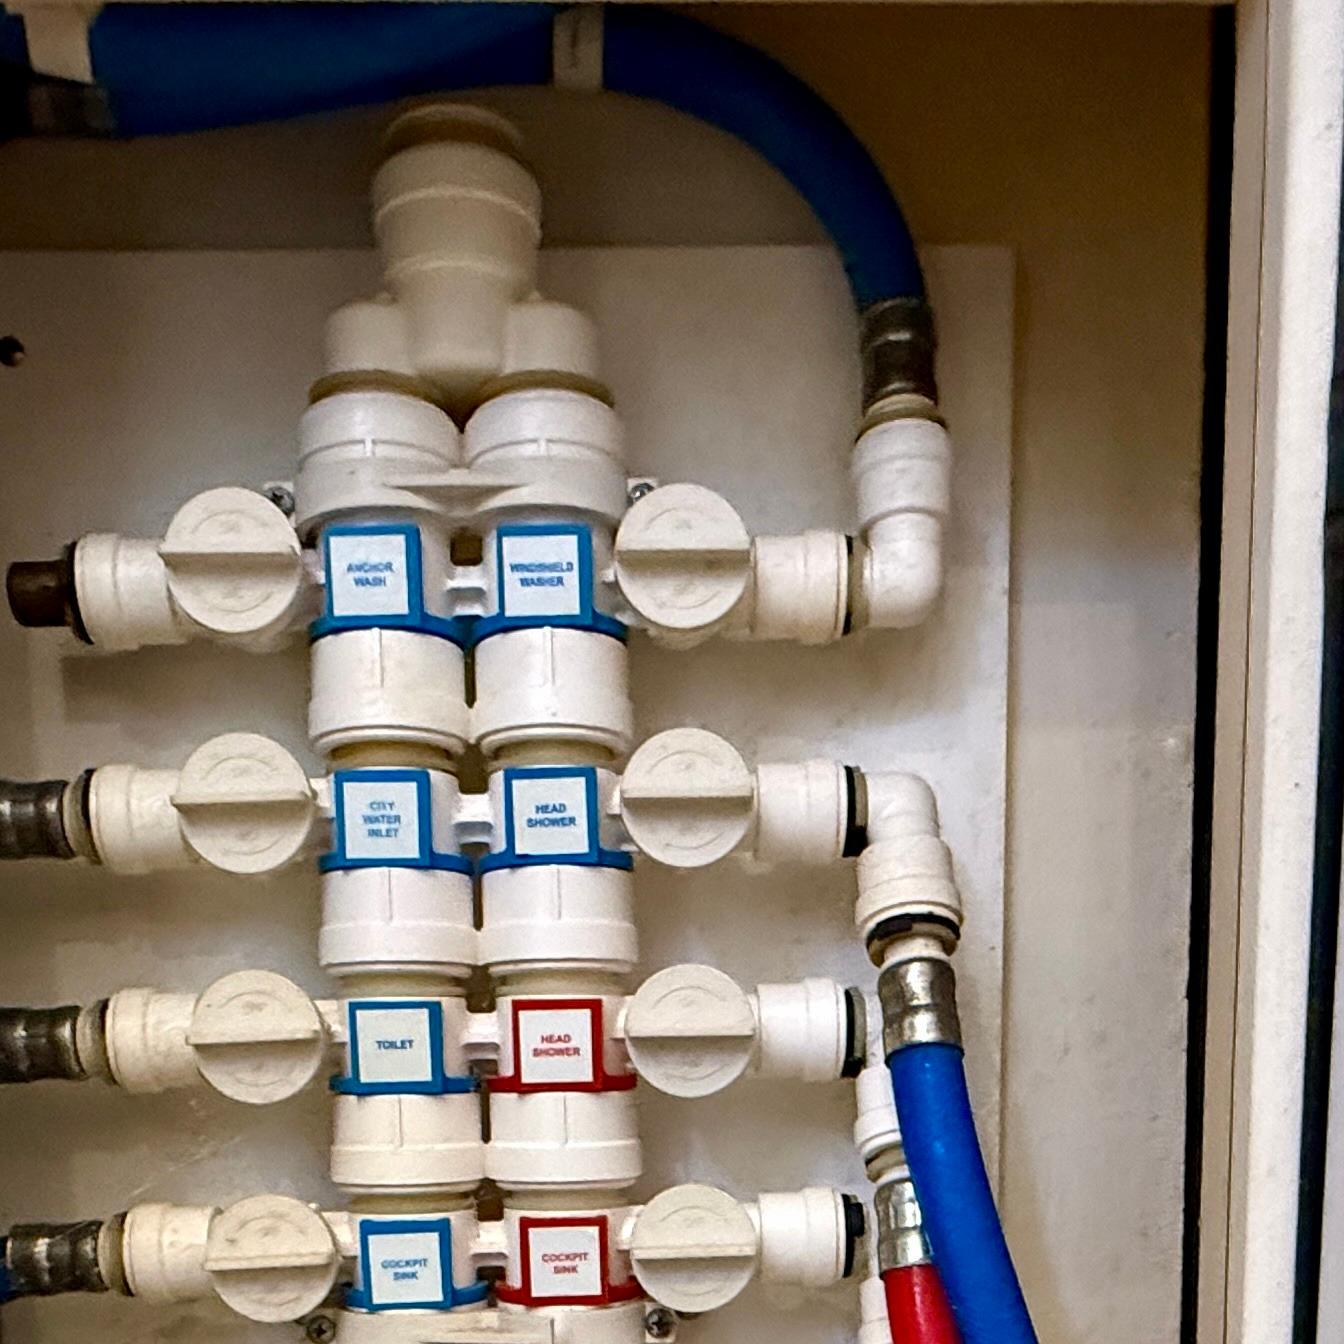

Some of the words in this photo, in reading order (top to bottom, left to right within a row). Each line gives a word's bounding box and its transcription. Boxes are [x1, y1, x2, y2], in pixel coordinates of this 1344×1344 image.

[354, 577, 386, 587] WASH
[519, 577, 564, 587] WASHER
[535, 804, 566, 813] HEAD
[362, 814, 401, 825] WATER
[527, 817, 576, 827] SHOWER
[367, 827, 399, 838] INLET
[377, 1039, 414, 1050] TOILET
[540, 1035, 571, 1044] HEAD
[532, 1047, 580, 1057] SHOWER
[541, 1253, 588, 1262] COCKPIT
[382, 1259, 427, 1269] COCKPIT
[553, 1263, 578, 1273] SINK
[393, 1271, 418, 1281] SINK
